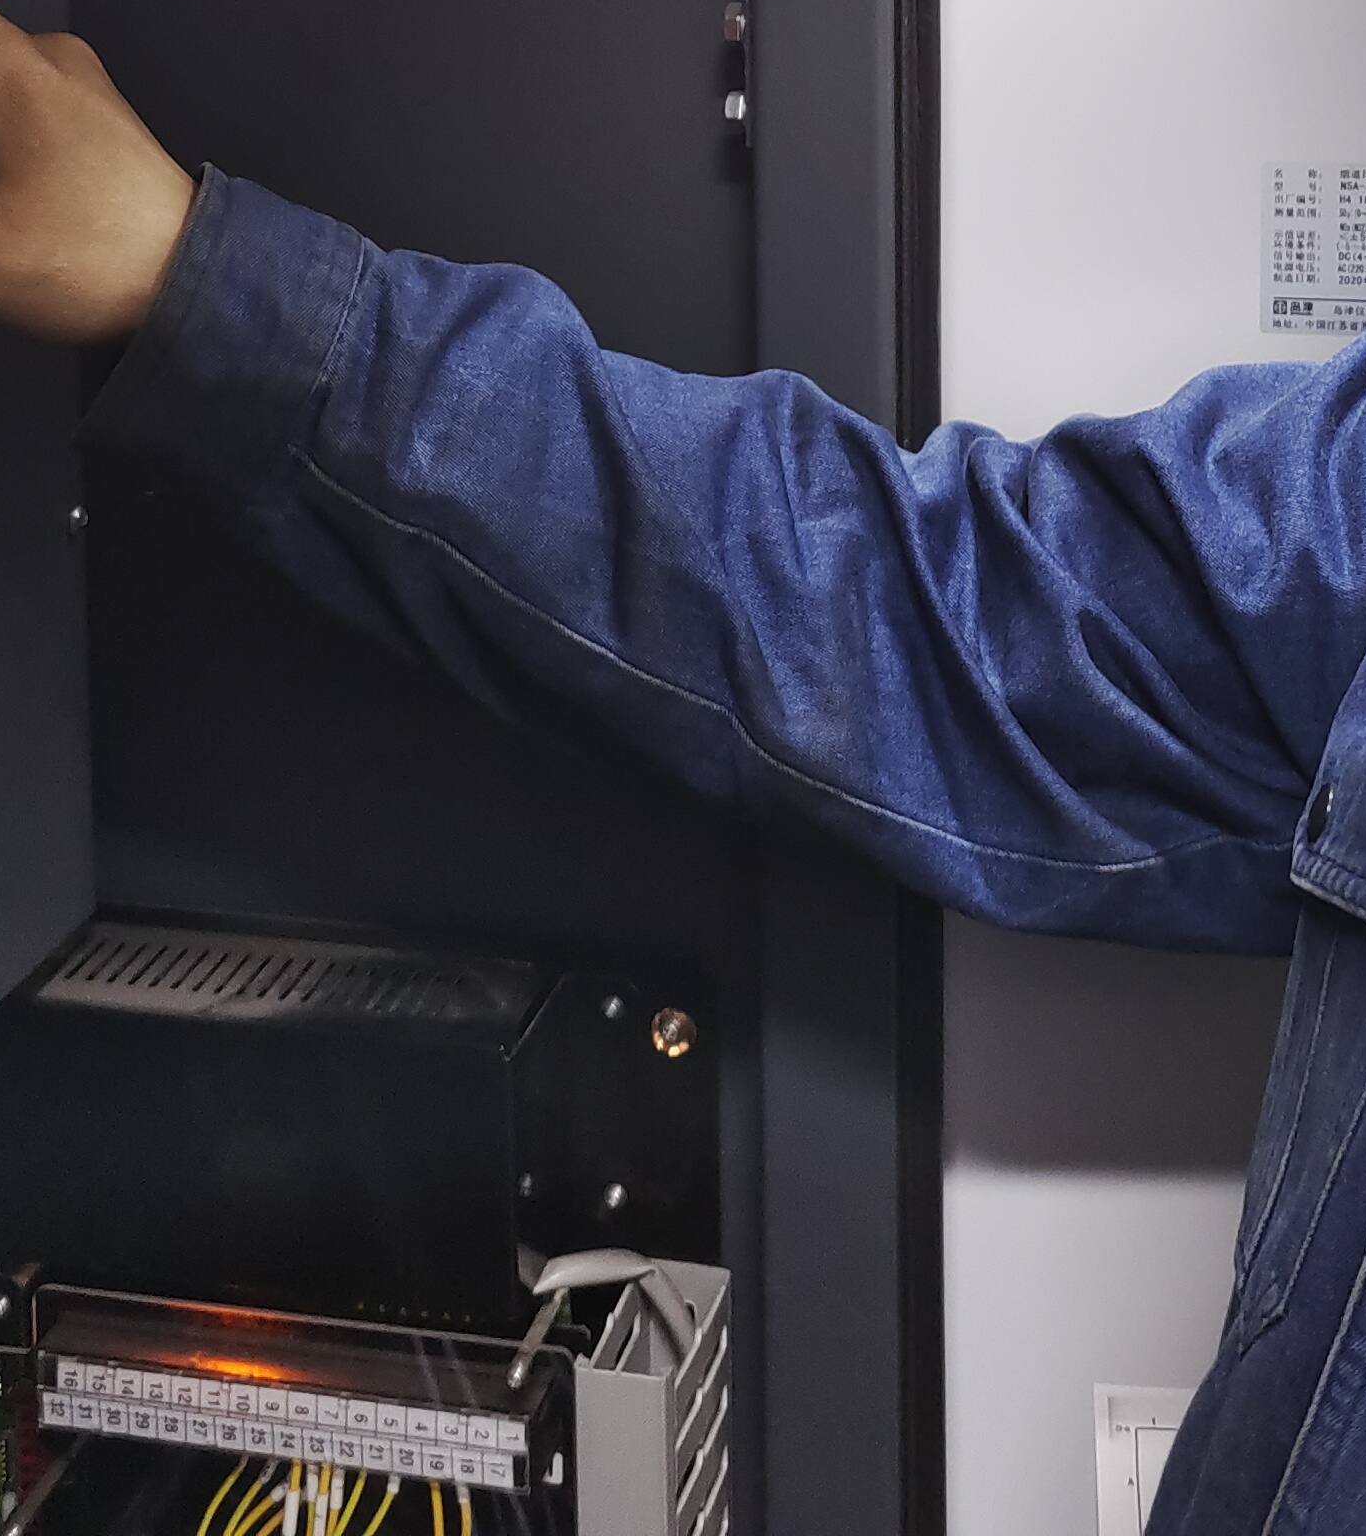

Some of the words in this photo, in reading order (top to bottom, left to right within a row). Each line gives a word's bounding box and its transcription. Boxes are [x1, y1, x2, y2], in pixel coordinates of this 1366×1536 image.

[63, 1369, 79, 1389] 16
[92, 1373, 107, 1392] 15
[121, 1378, 134, 1396] 14
[149, 1380, 164, 1400] 13
[177, 1385, 192, 1405] 12
[207, 1390, 221, 1408] 11
[235, 1393, 251, 1412] 10
[265, 1401, 280, 1411] 9
[294, 1405, 310, 1415] 8
[323, 1410, 339, 1420] 7
[353, 1414, 369, 1424] 6
[384, 1418, 399, 1427] 5
[414, 1421, 429, 1432] 4
[444, 1425, 459, 1437] 3
[474, 1429, 490, 1440] 2
